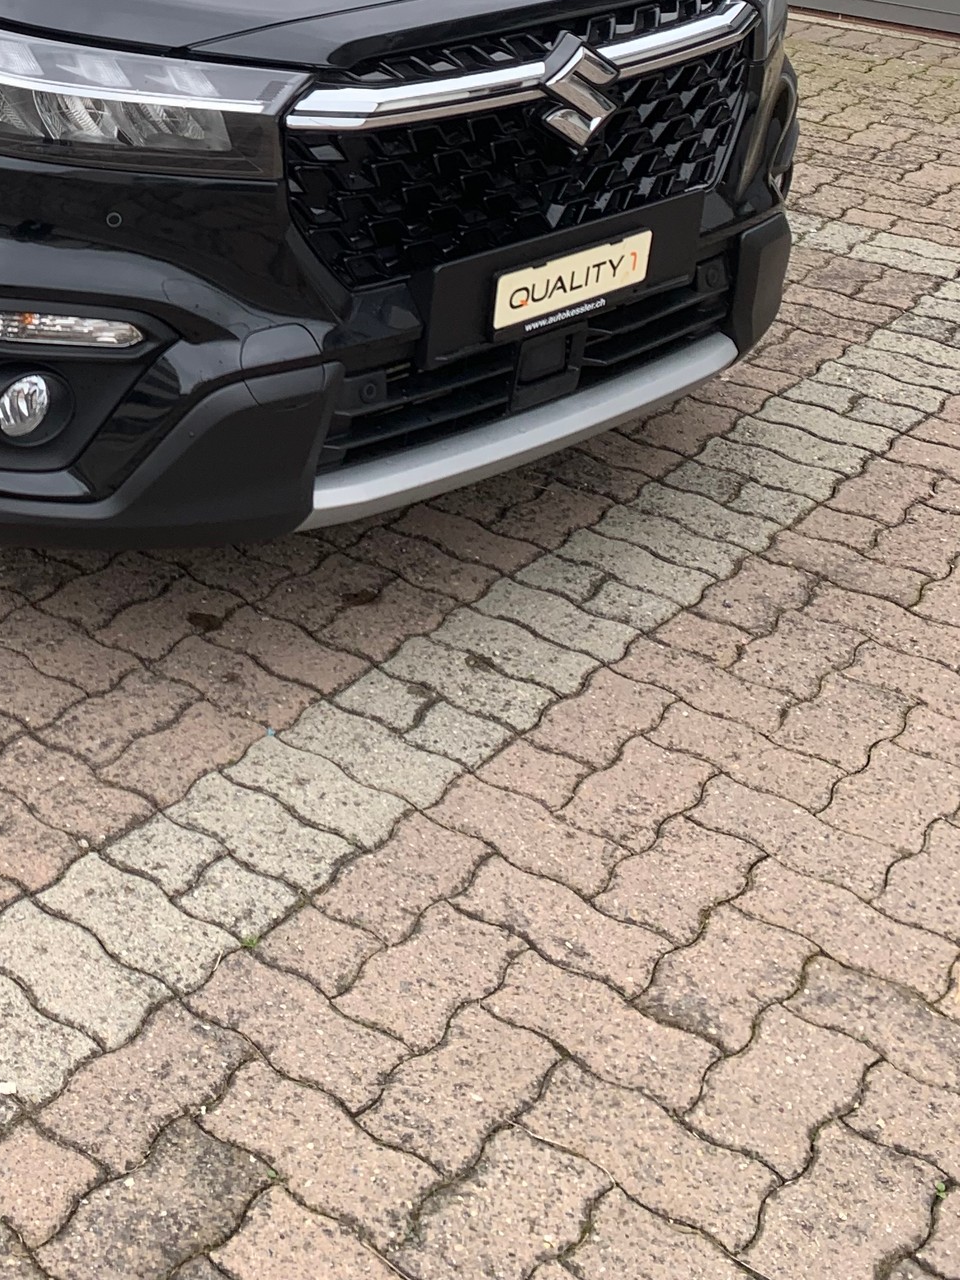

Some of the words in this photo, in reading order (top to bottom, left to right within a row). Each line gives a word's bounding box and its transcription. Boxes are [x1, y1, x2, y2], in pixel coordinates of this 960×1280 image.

[509, 255, 625, 310] QUALITY
[630, 251, 638, 272] 1
[524, 297, 607, 332] www.autokessler.ch
